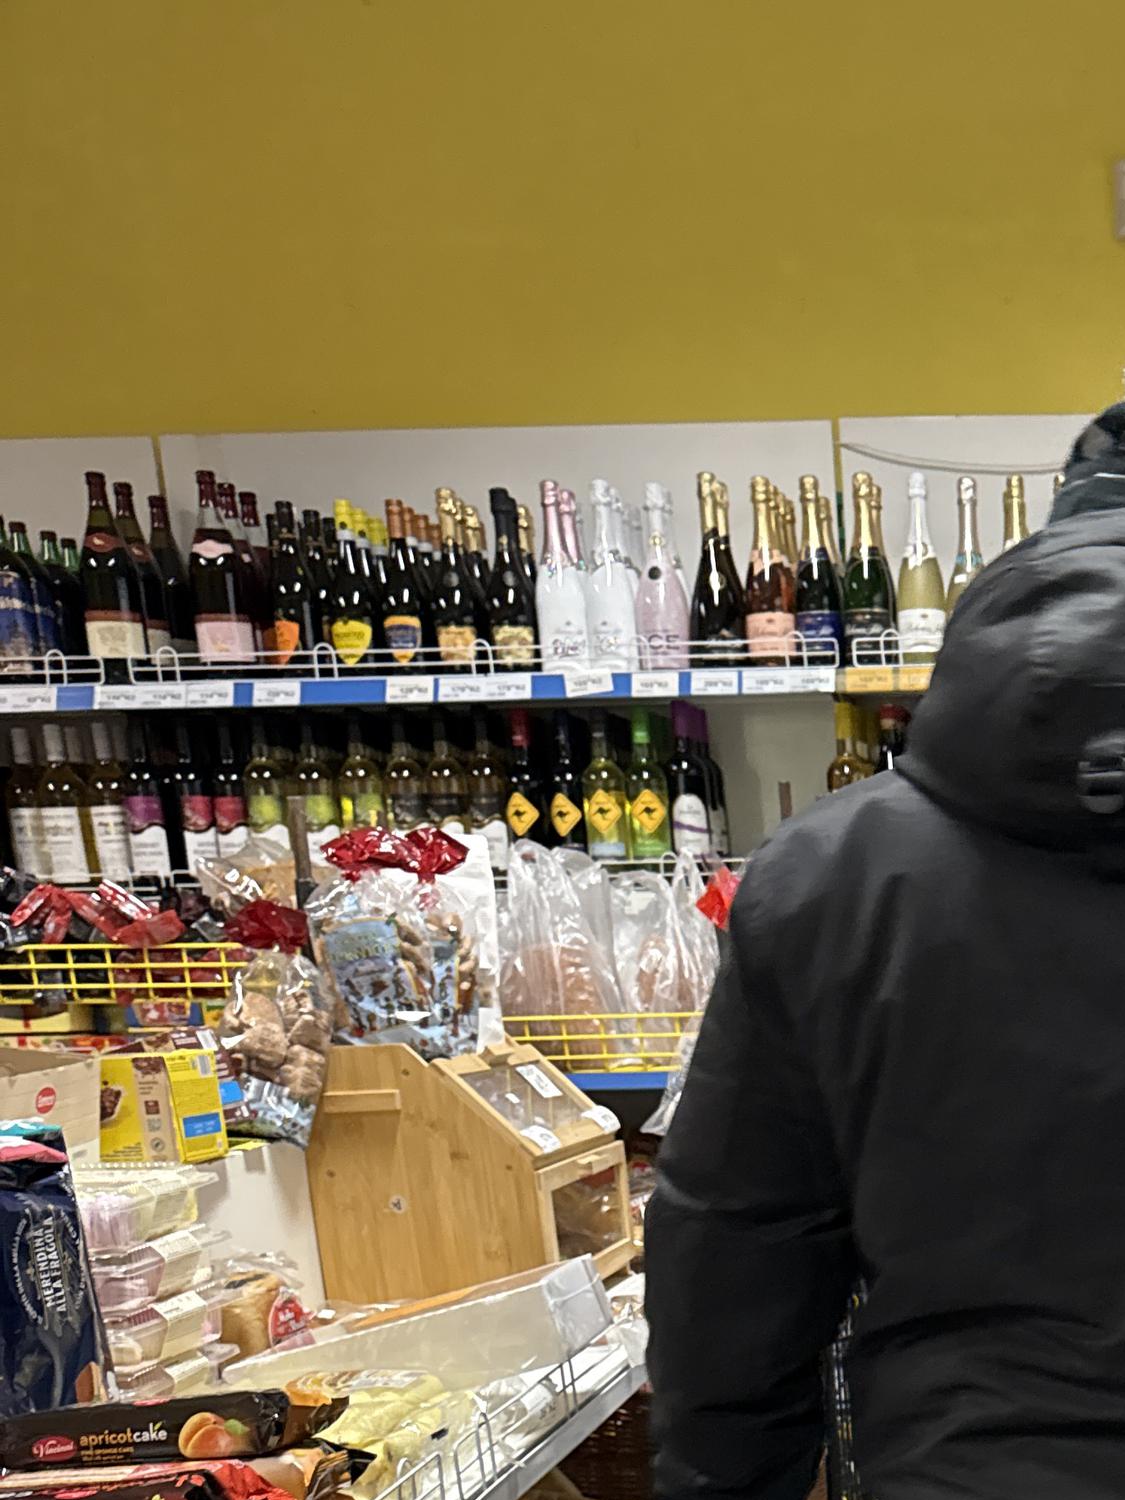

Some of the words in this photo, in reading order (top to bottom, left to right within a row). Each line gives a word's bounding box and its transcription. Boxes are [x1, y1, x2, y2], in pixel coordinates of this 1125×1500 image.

[646, 634, 681, 651] CE
[33, 1227, 55, 1308] MERENDINA
[43, 1216, 64, 1280] FRAGOLA
[54, 1280, 67, 1312] ALLA
